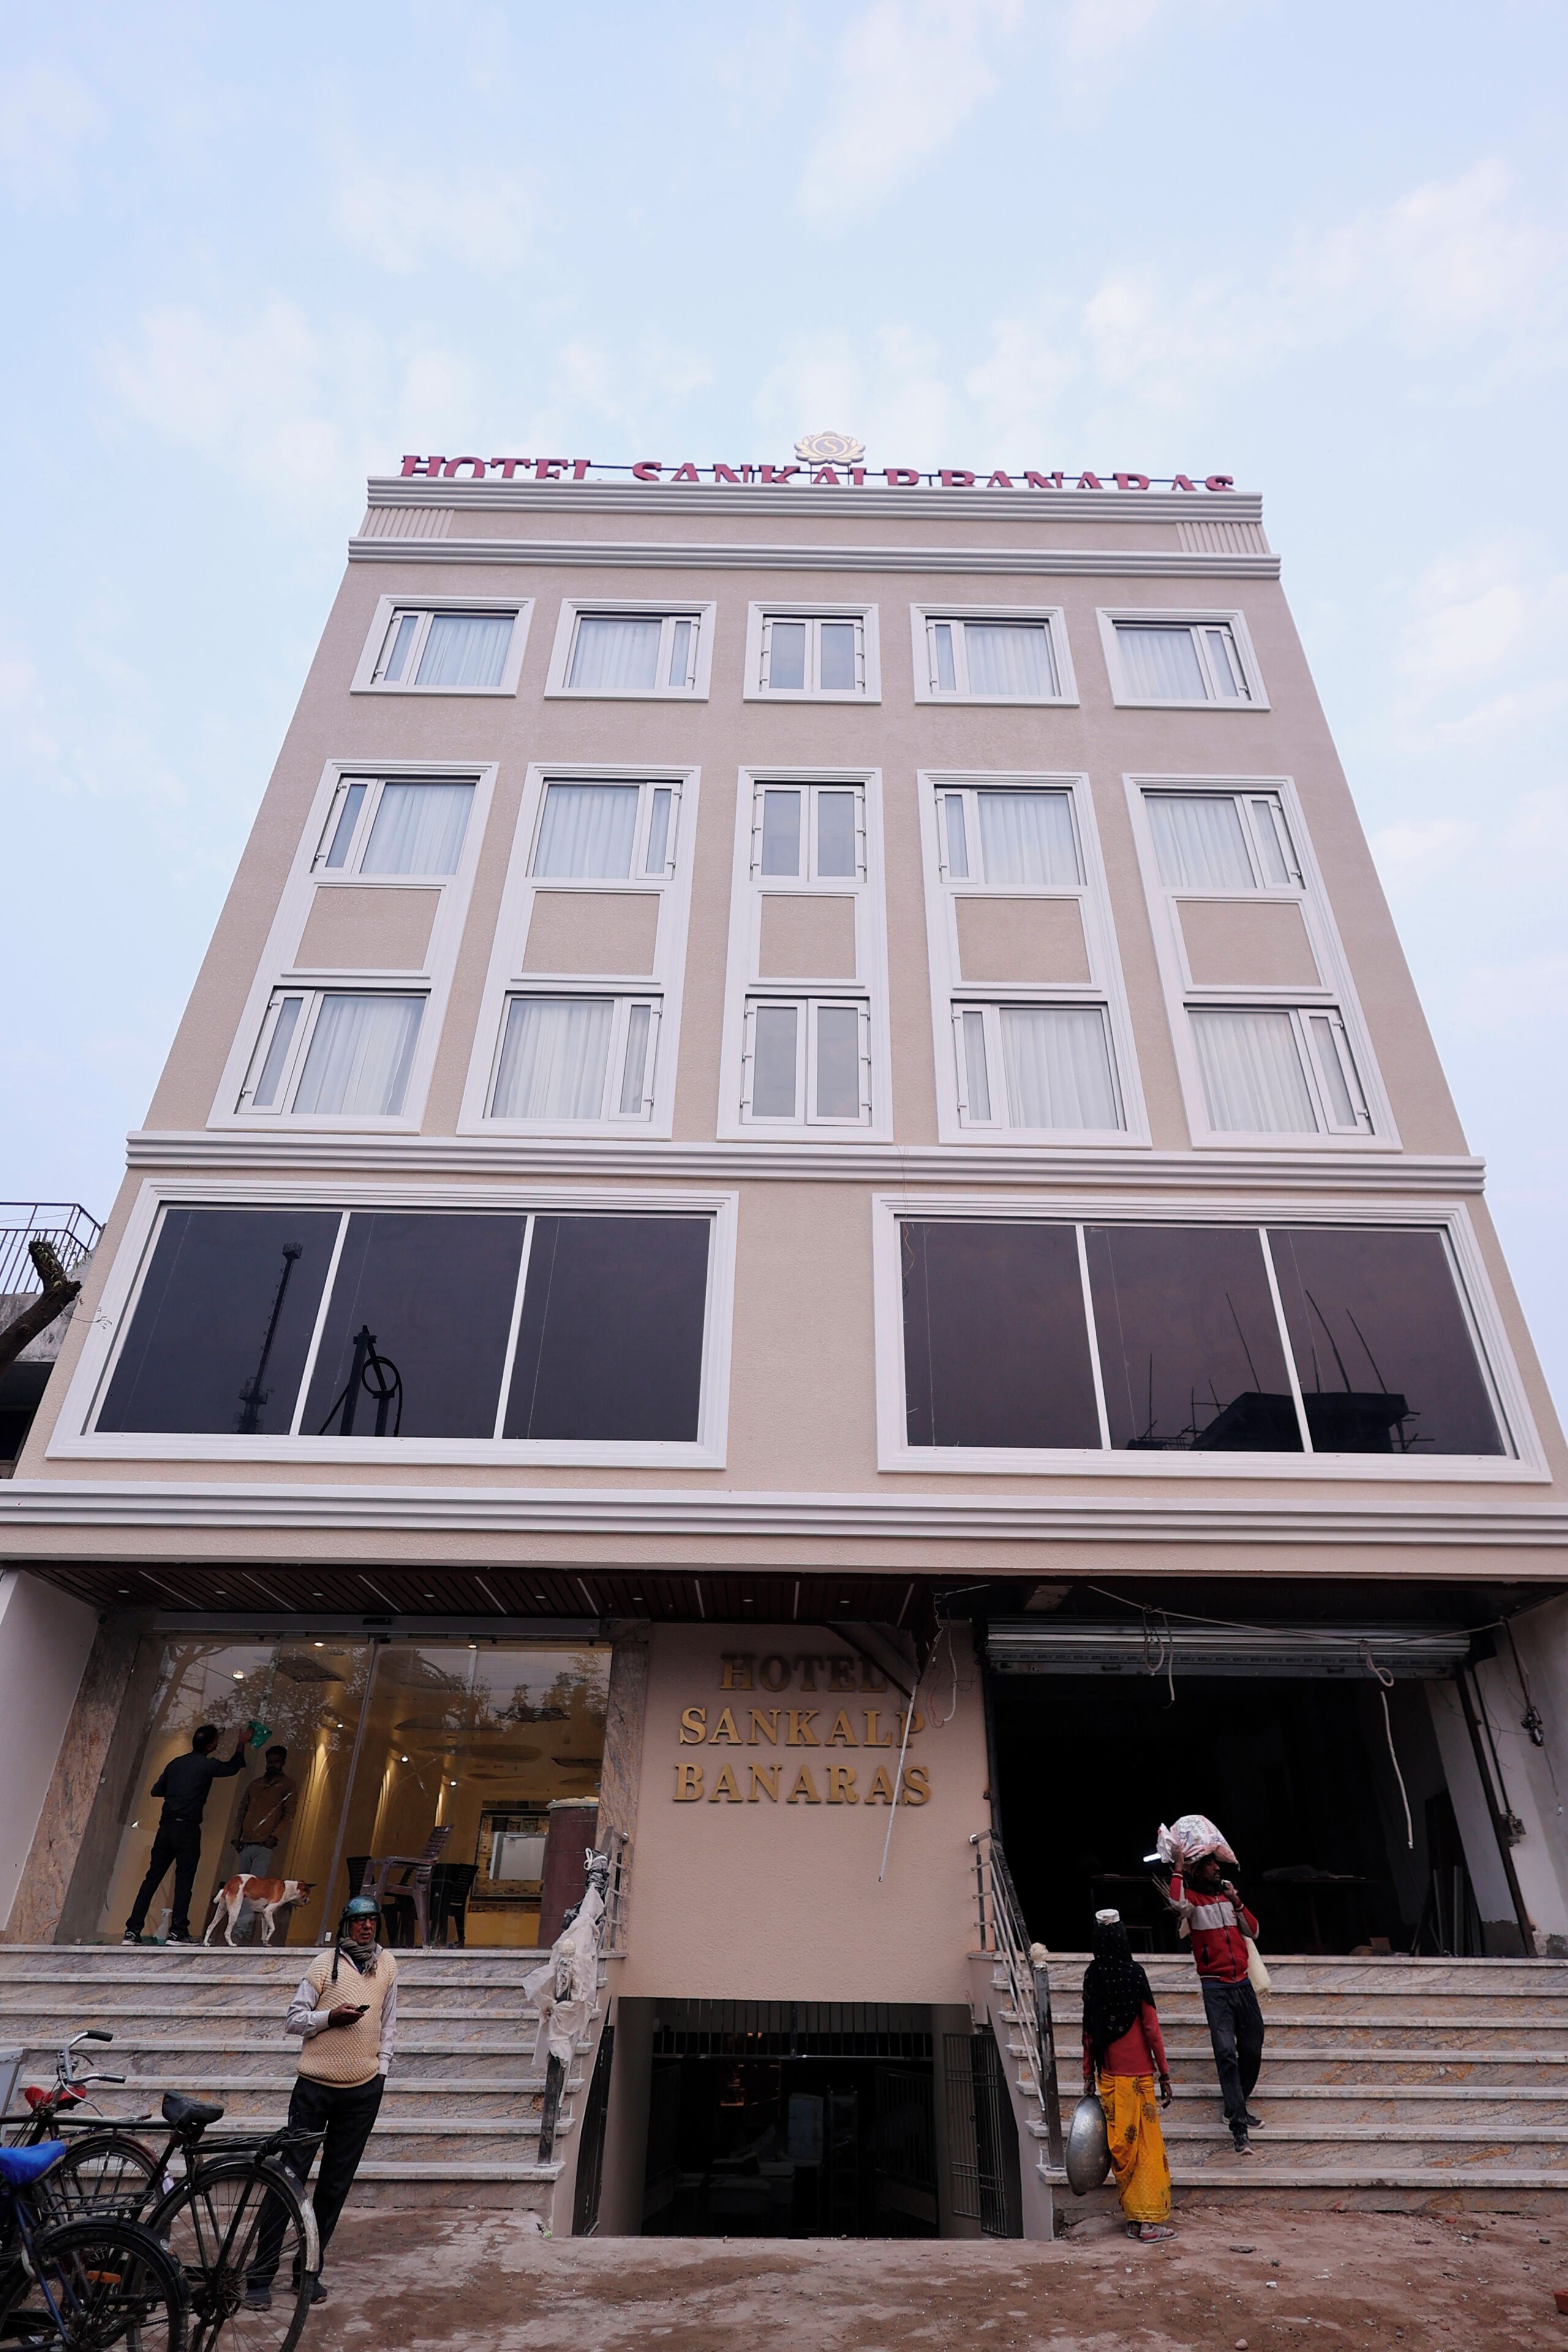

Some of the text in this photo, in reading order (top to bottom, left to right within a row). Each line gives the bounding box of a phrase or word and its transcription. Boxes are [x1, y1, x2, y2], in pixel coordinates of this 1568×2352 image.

[822, 439, 839, 454] S
[720, 1654, 888, 1692] HOTEL
[679, 1707, 925, 1748] SANKALP
[673, 1763, 931, 1805] BANARAS
